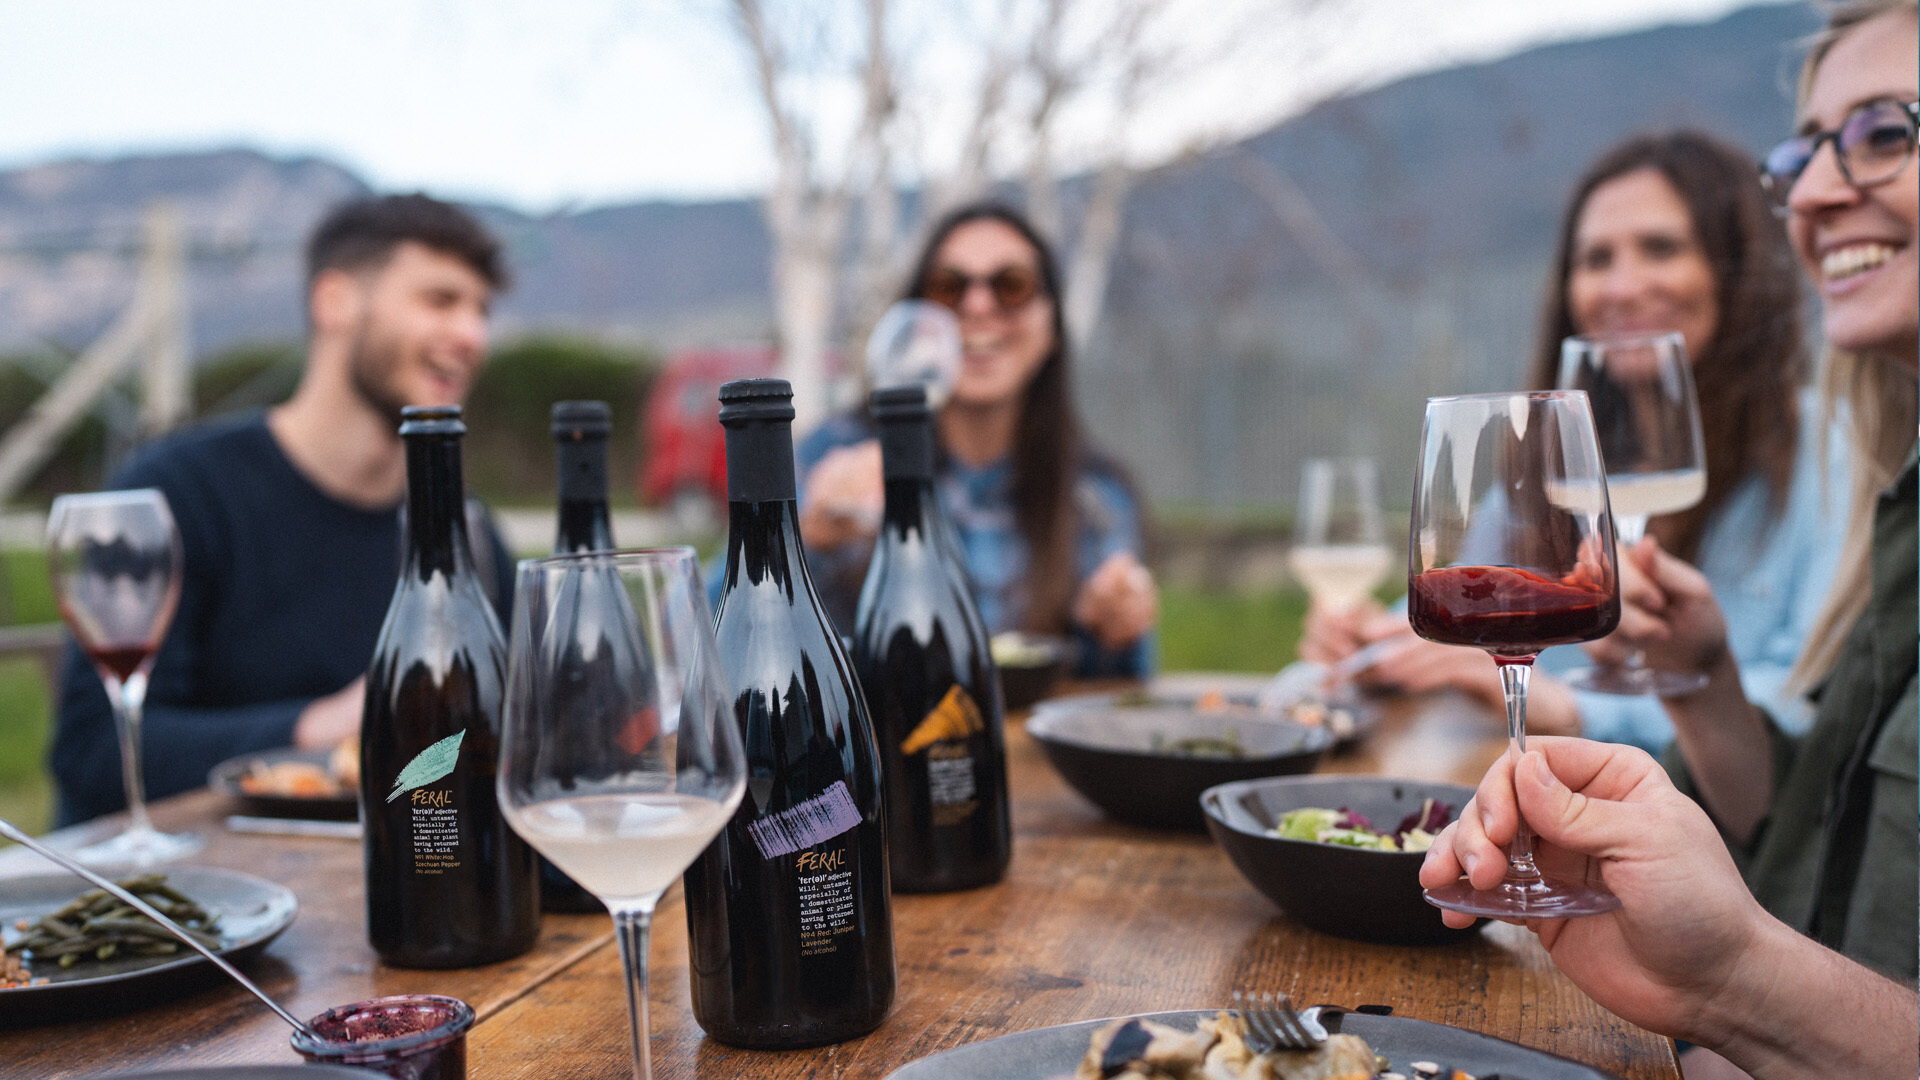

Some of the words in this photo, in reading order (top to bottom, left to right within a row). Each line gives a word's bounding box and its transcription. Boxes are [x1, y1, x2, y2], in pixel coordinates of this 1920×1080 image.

[411, 790, 452, 807] FERAL
[796, 849, 845, 872] FERAL
[799, 890, 840, 901] especially
[809, 894, 853, 906] domesticated
[800, 907, 823, 916] animal
[836, 902, 854, 911] plant
[800, 915, 824, 924] having
[827, 909, 854, 920] returned
[814, 922, 827, 930] the
[829, 918, 849, 927] wild.
[801, 938, 832, 948] Lavender
